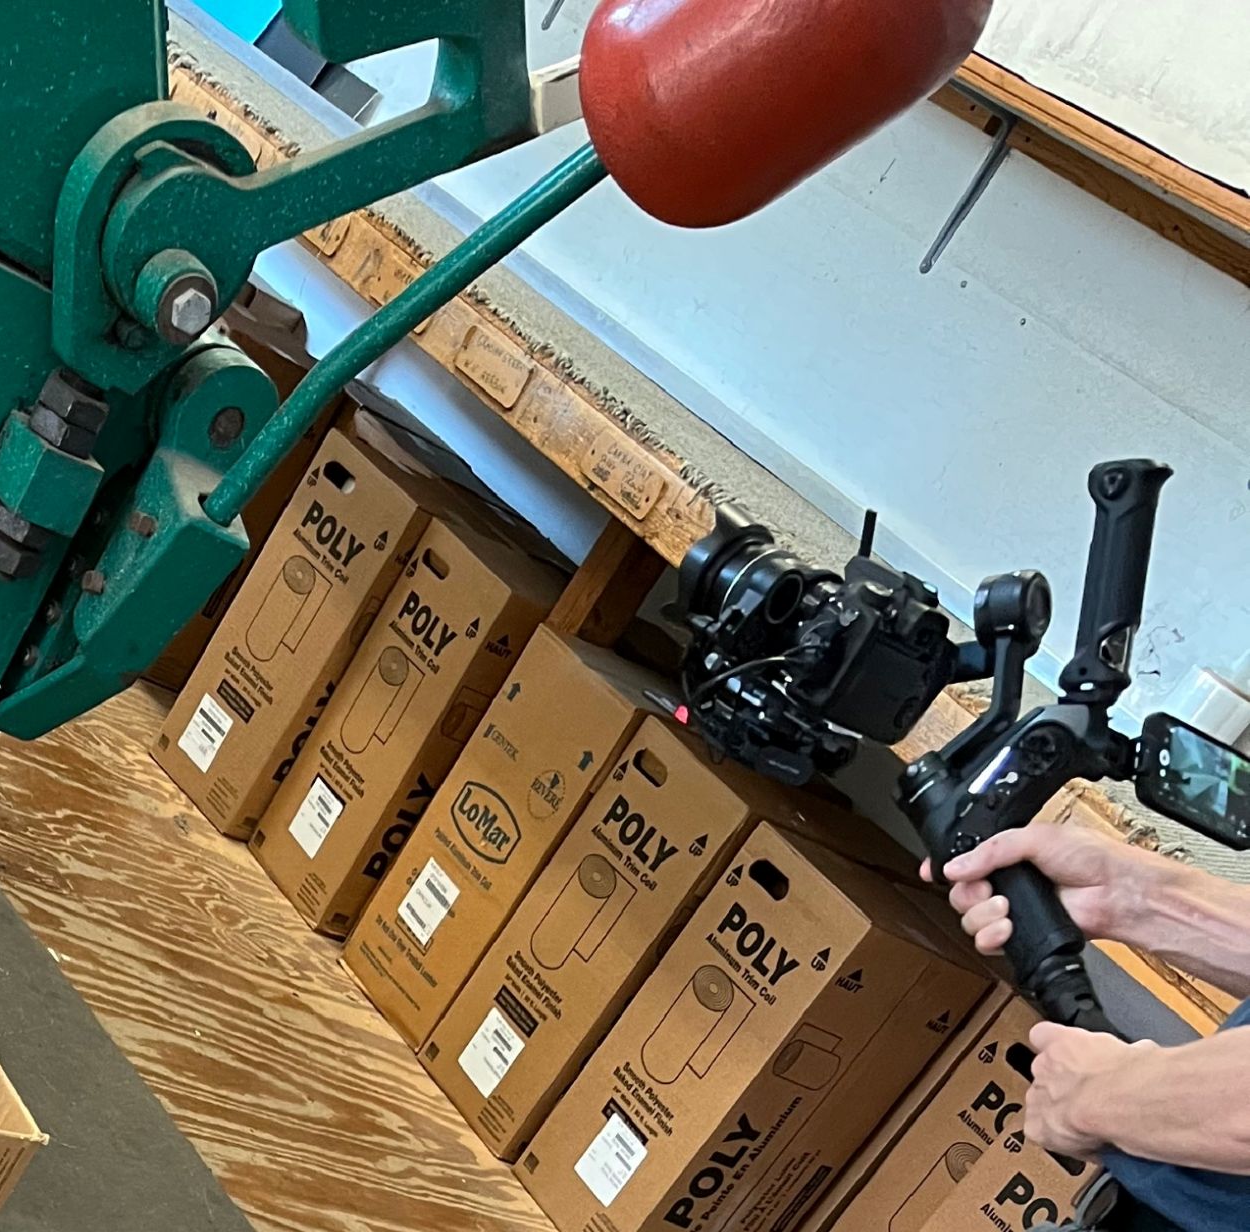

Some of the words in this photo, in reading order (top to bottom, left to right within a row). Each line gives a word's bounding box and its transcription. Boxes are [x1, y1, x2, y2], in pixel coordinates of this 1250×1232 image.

[301, 500, 365, 567] POLY
[374, 539, 385, 551] UP
[398, 590, 457, 656] POLY
[466, 625, 476, 639] UP
[613, 769, 623, 781] UP
[363, 772, 436, 881] POLY
[453, 788, 510, 852] LoMar
[602, 795, 678, 872] POLY
[591, 825, 623, 861] Aluminum
[624, 856, 640, 876] Trim
[640, 873, 657, 891] Coil
[689, 843, 703, 856] UP
[726, 873, 739, 887] UP
[706, 933, 741, 972] Aluminum
[742, 968, 759, 990] Trim
[759, 987, 776, 1005] Coil
[717, 902, 799, 985] POLY
[811, 956, 825, 971] UP
[835, 976, 864, 994] HAUT
[978, 1050, 994, 1065] UP
[957, 1109, 995, 1146] Aluminu
[971, 1080, 1022, 1135] PO
[664, 1113, 761, 1228] POLY
[700, 1183, 734, 1220] Peinte
[733, 1164, 750, 1180] En
[749, 1097, 802, 1161] Aluminium
[1003, 1137, 1022, 1154] UP
